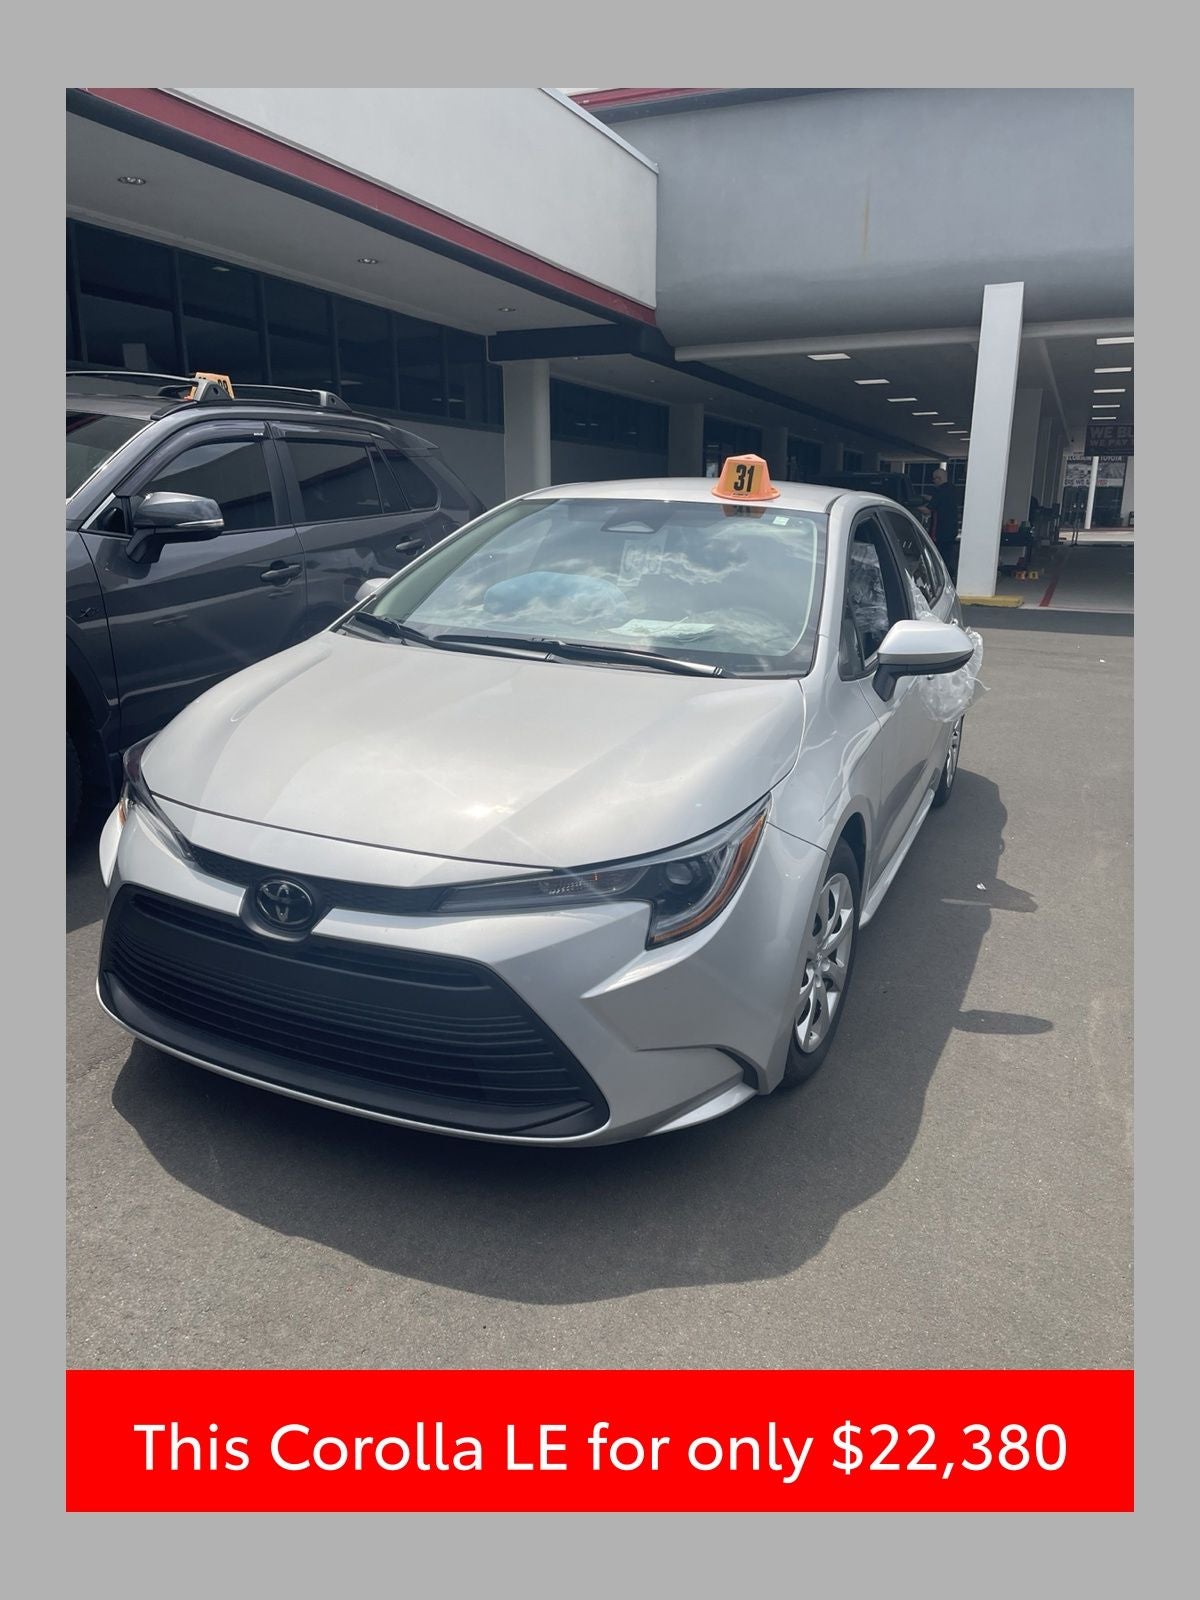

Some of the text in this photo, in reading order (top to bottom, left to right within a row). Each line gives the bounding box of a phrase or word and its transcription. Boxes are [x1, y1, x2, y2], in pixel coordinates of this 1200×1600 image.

[1090, 426, 1113, 438] WE
[1090, 439, 1105, 447] WE
[733, 464, 755, 492] 31
